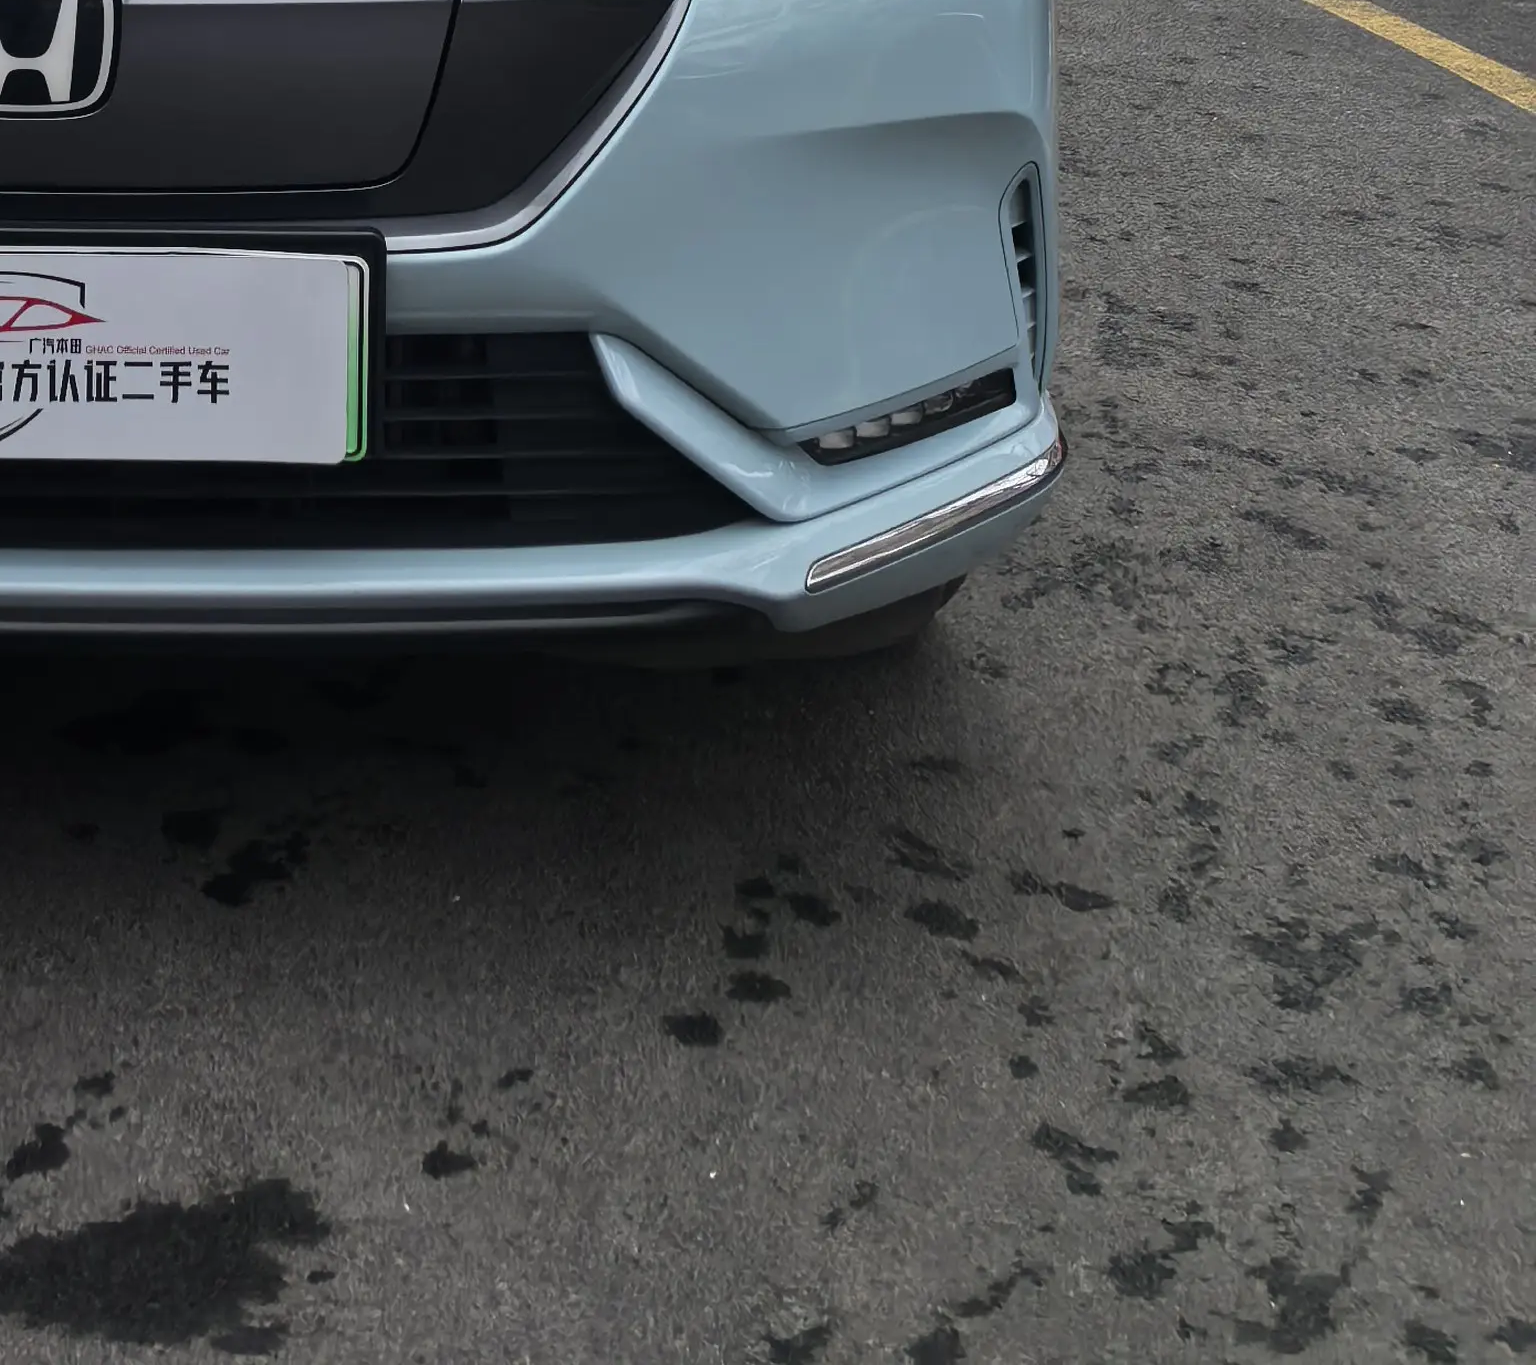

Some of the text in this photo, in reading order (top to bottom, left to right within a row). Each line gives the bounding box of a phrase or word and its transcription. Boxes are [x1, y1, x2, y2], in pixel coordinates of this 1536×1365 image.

[28, 337, 230, 356] 广汽本田 GHAC Official Certified Used Car
